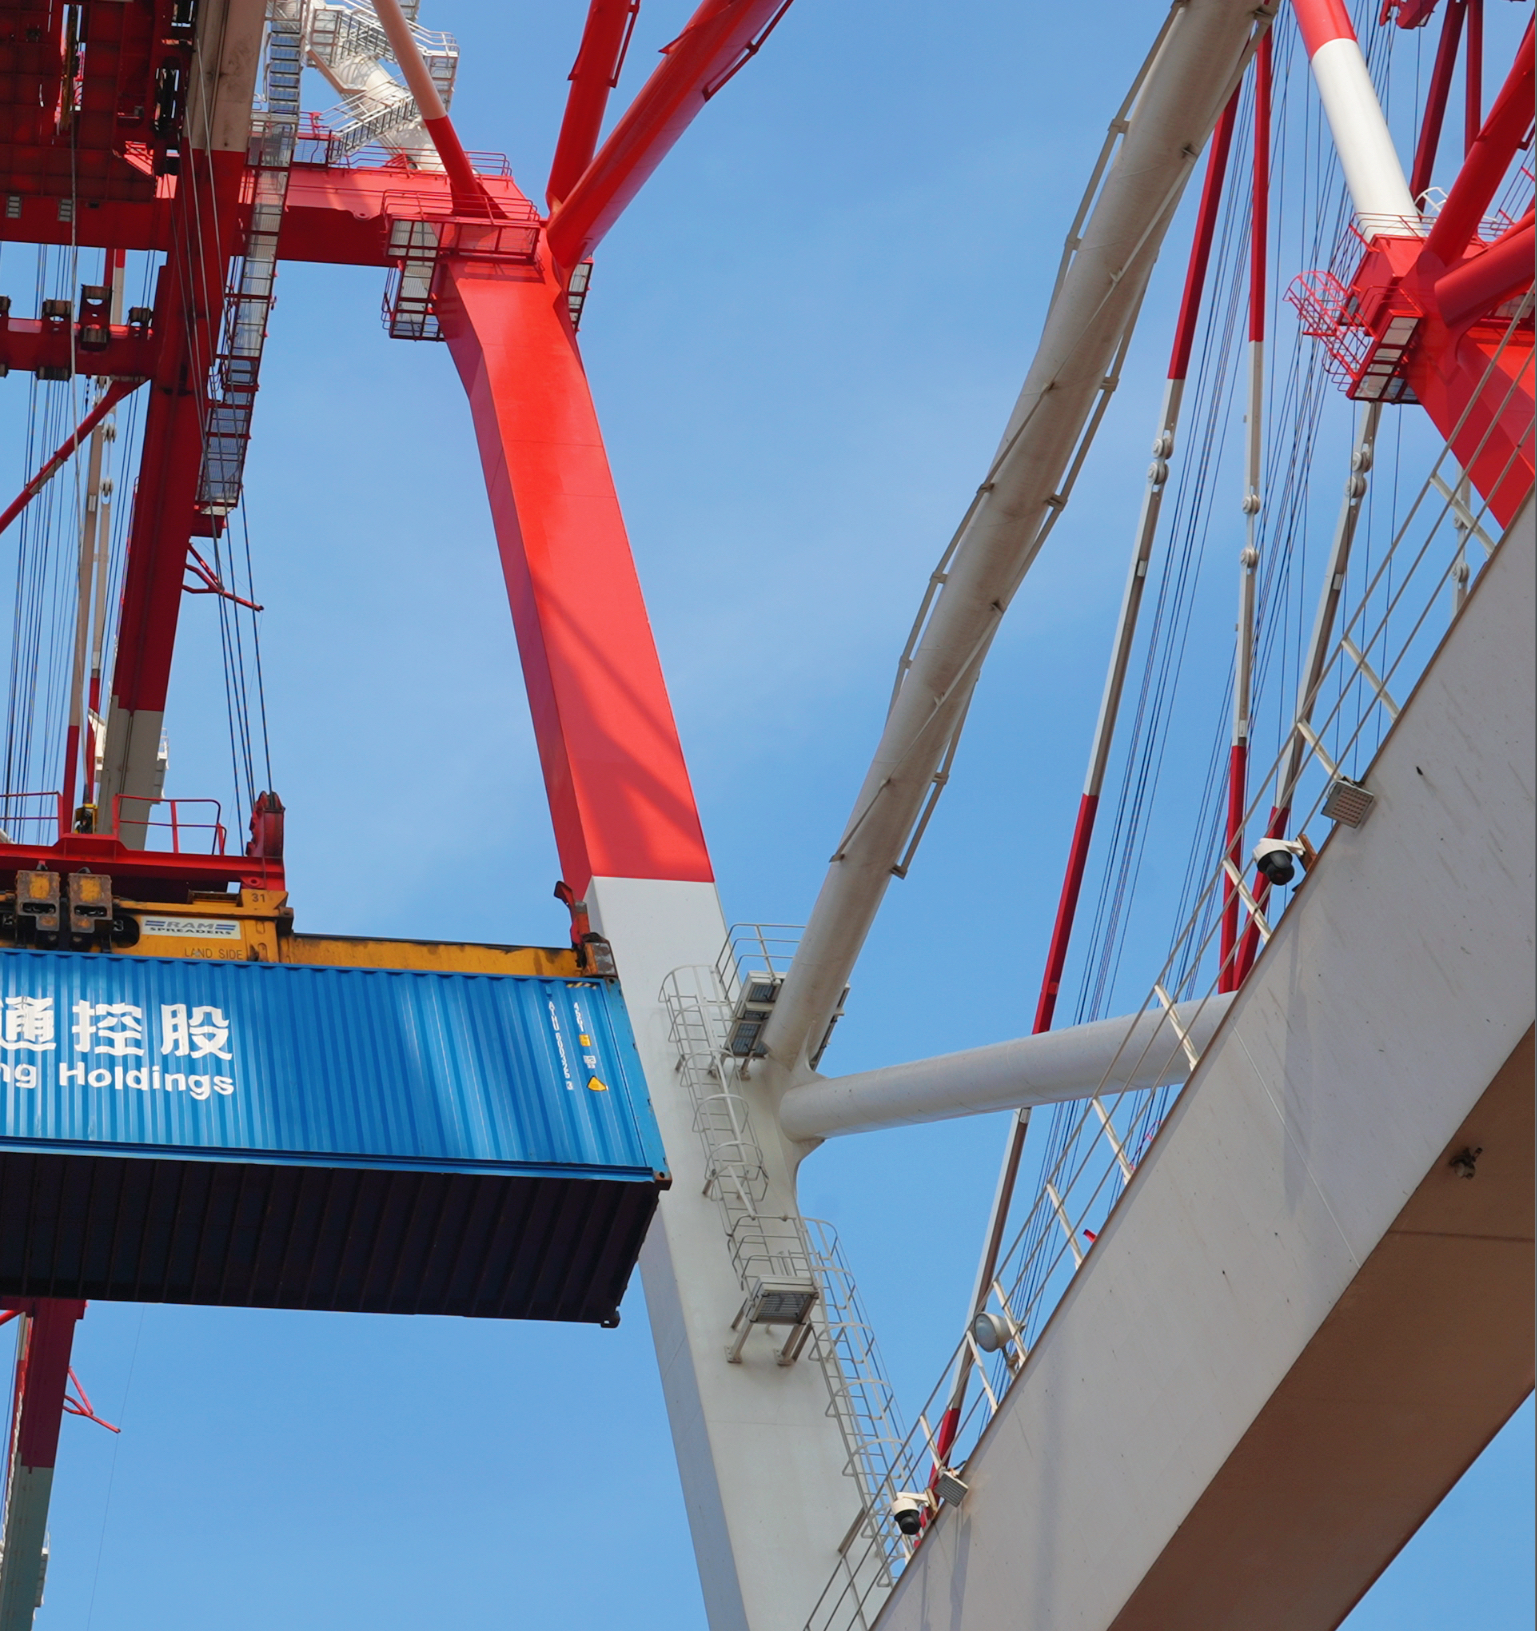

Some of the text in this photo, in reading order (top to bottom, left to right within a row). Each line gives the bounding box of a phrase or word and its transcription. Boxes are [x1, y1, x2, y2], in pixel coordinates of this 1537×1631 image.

[251, 892, 266, 903] 31
[149, 926, 232, 935] SPREADERS
[166, 921, 215, 930] RAM
[184, 947, 243, 960] LAND SIDE
[59, 1061, 235, 1100] Holdings
